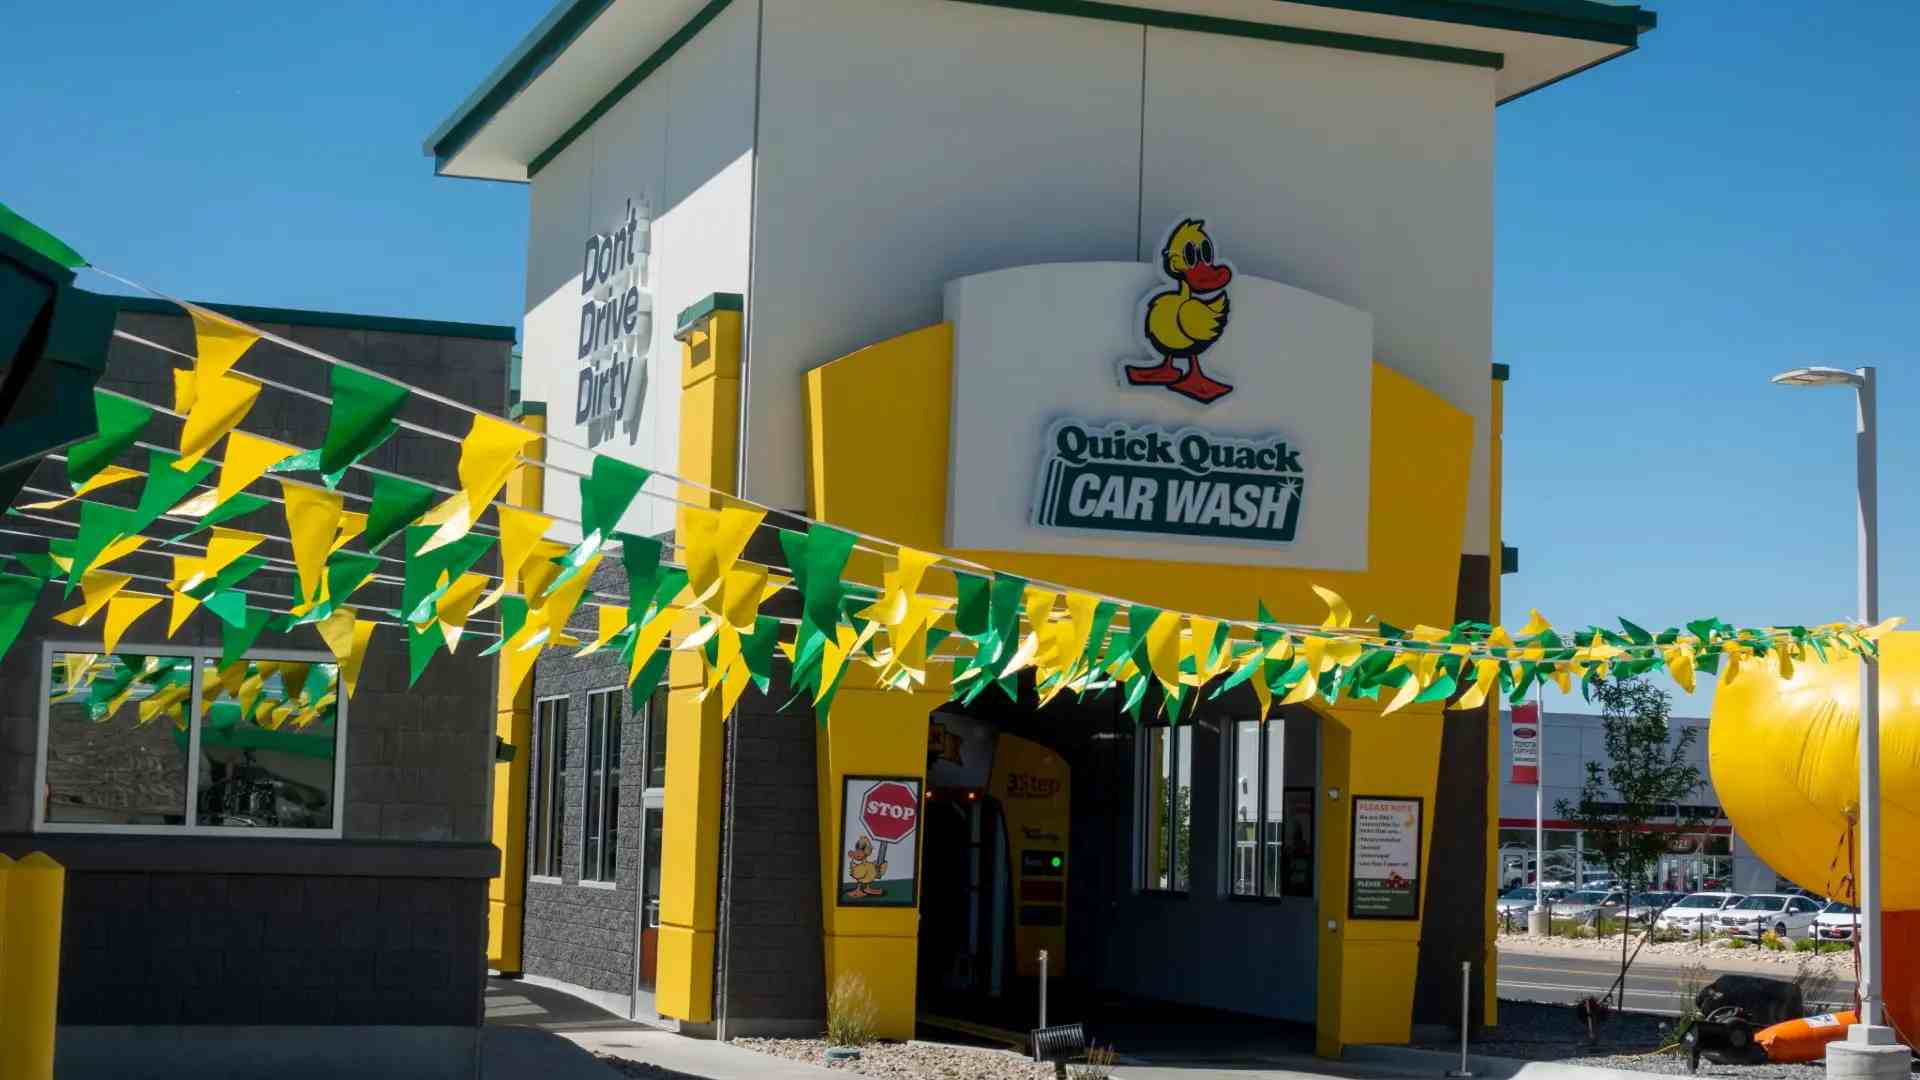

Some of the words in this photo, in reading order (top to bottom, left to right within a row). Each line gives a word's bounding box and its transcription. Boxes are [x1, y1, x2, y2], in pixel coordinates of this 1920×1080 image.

[581, 197, 638, 296] Don't
[577, 285, 639, 361] Drive
[575, 351, 634, 426] Dirty
[1056, 425, 1175, 465] Quick
[1179, 434, 1304, 473] Quack
[1068, 473, 1159, 521] CAR
[1164, 478, 1294, 530] WASH
[866, 800, 915, 821] STOP
